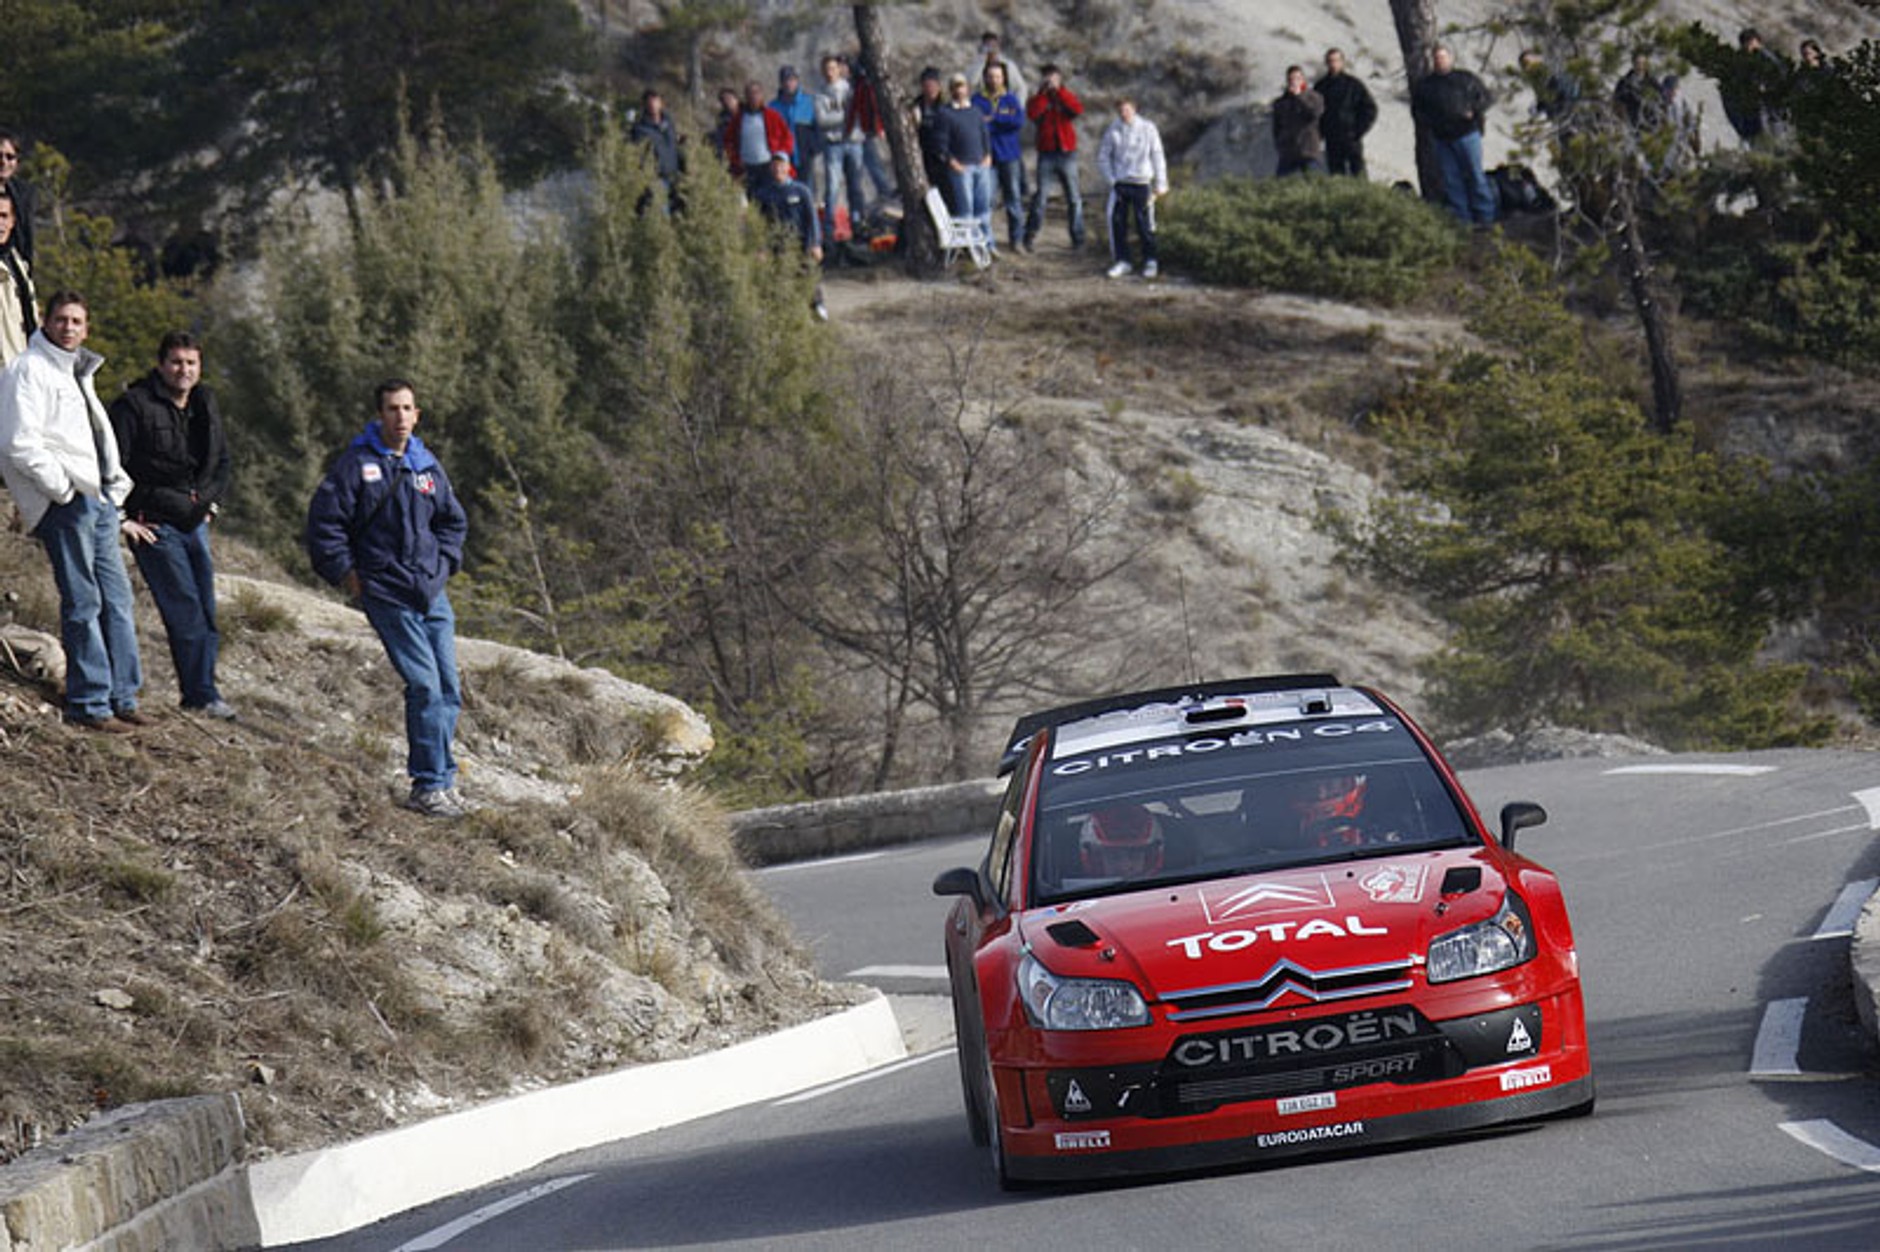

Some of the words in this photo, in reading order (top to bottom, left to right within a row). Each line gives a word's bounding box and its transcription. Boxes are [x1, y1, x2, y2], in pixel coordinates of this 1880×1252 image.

[1053, 728, 1300, 775] CITROËN
[1313, 720, 1394, 736] C4
[1166, 916, 1388, 959] TOTAL
[1174, 1012, 1418, 1066] CITROËN
[1332, 1056, 1419, 1083] SPORT
[1257, 1121, 1363, 1147] EURODATACAR
